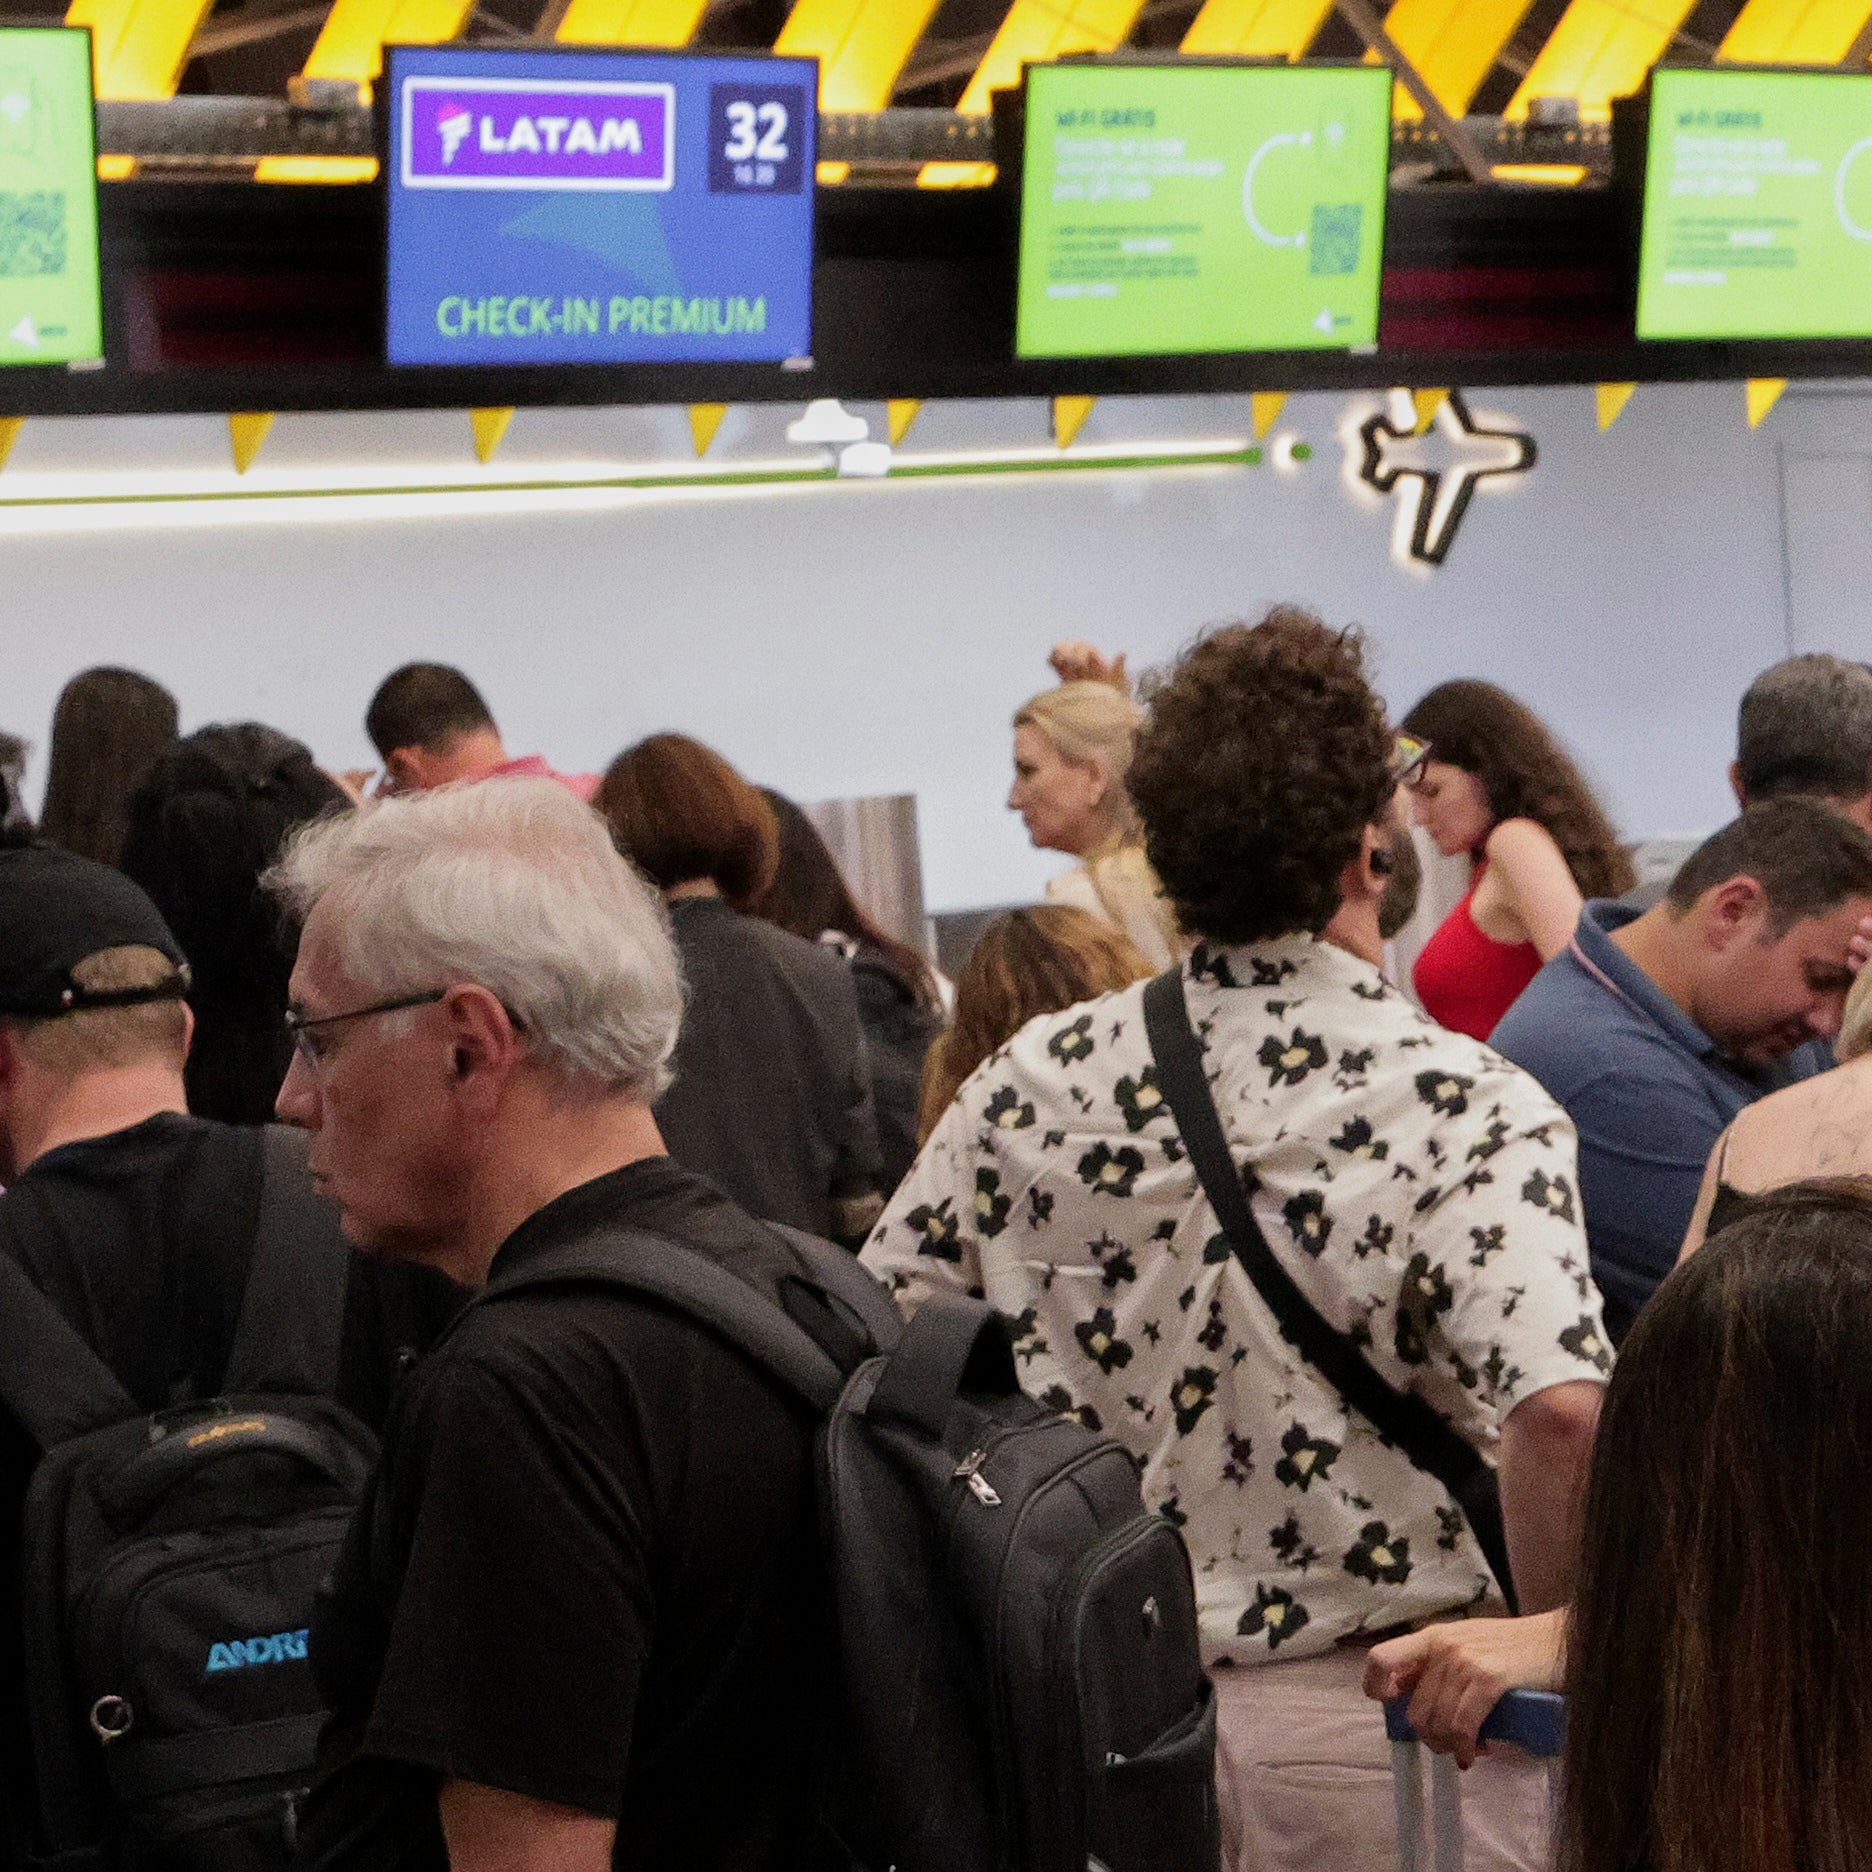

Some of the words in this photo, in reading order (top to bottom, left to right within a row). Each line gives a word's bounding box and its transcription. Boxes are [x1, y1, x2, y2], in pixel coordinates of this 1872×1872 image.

[479, 115, 643, 154] LATAM
[725, 101, 789, 162] 32
[437, 296, 598, 337] CHECK-IN
[608, 295, 766, 336] PREMIUM
